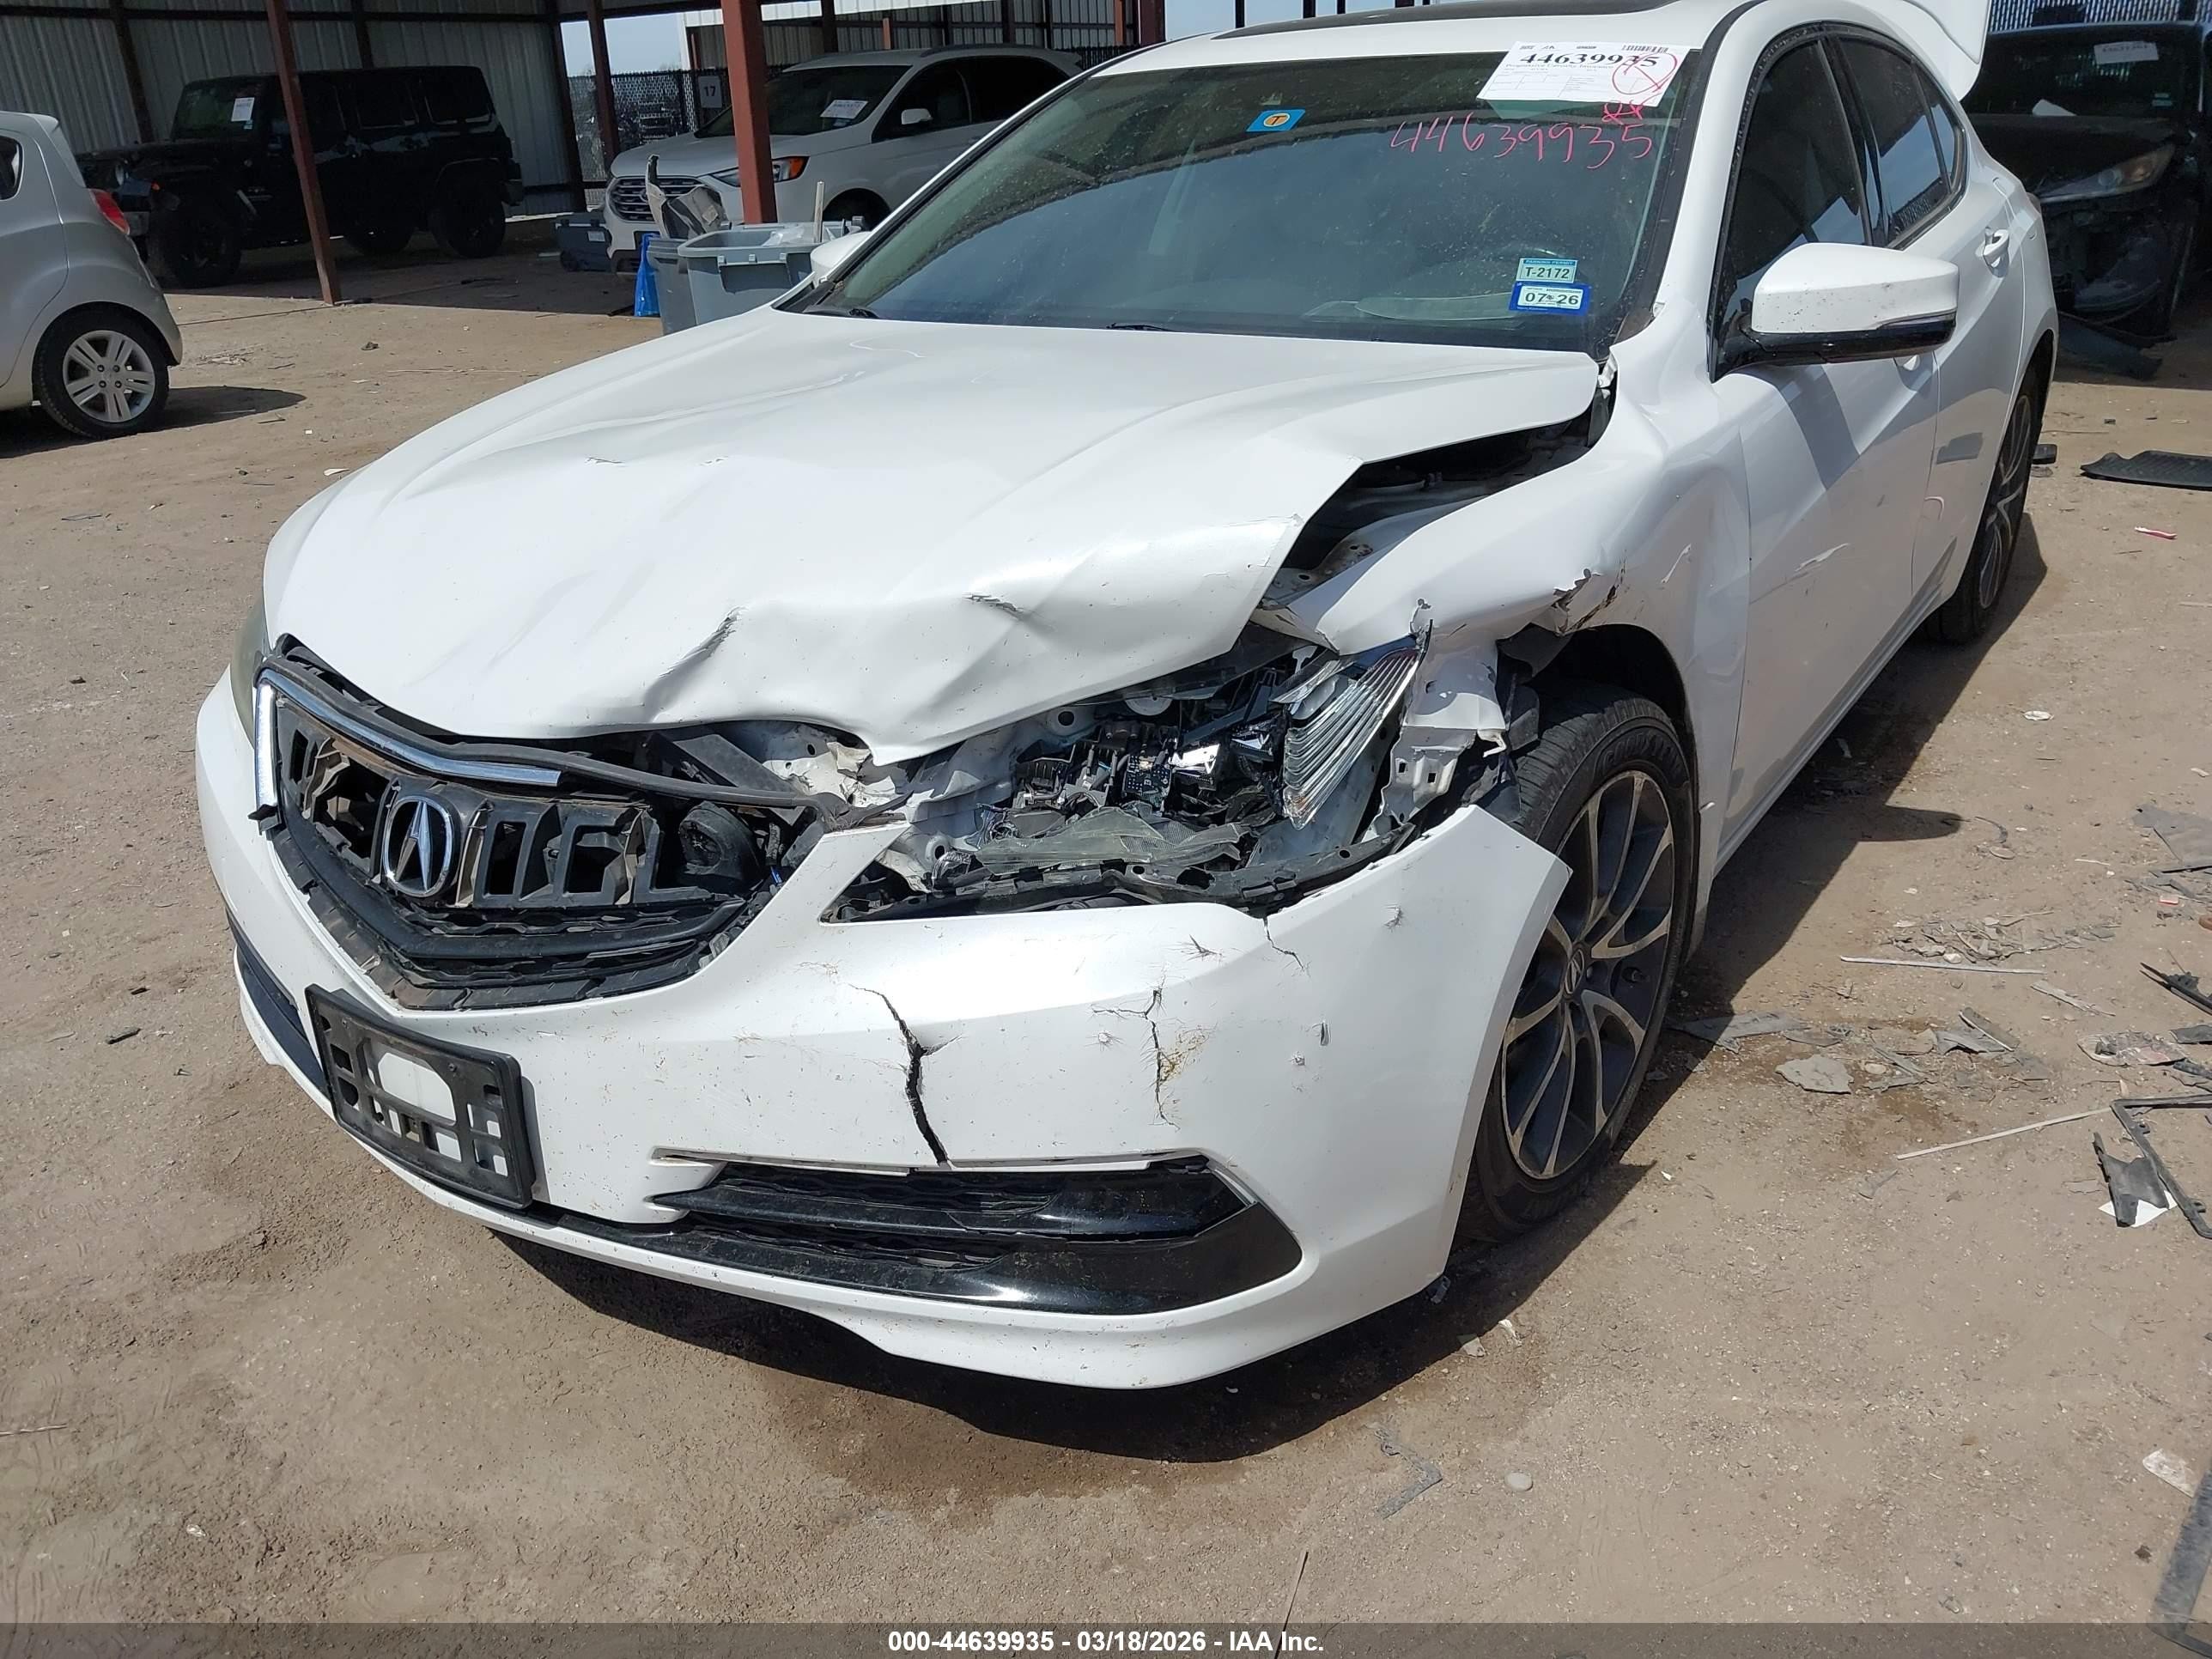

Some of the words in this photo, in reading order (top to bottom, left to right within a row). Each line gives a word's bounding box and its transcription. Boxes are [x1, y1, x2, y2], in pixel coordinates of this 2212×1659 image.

[1519, 53, 1662, 68] 44639935
[704, 86, 715, 96] 17
[1390, 112, 1652, 169] 44639935
[1525, 266, 1570, 279] T-2172
[1525, 292, 1547, 302] 07
[1557, 294, 1579, 305] 26
